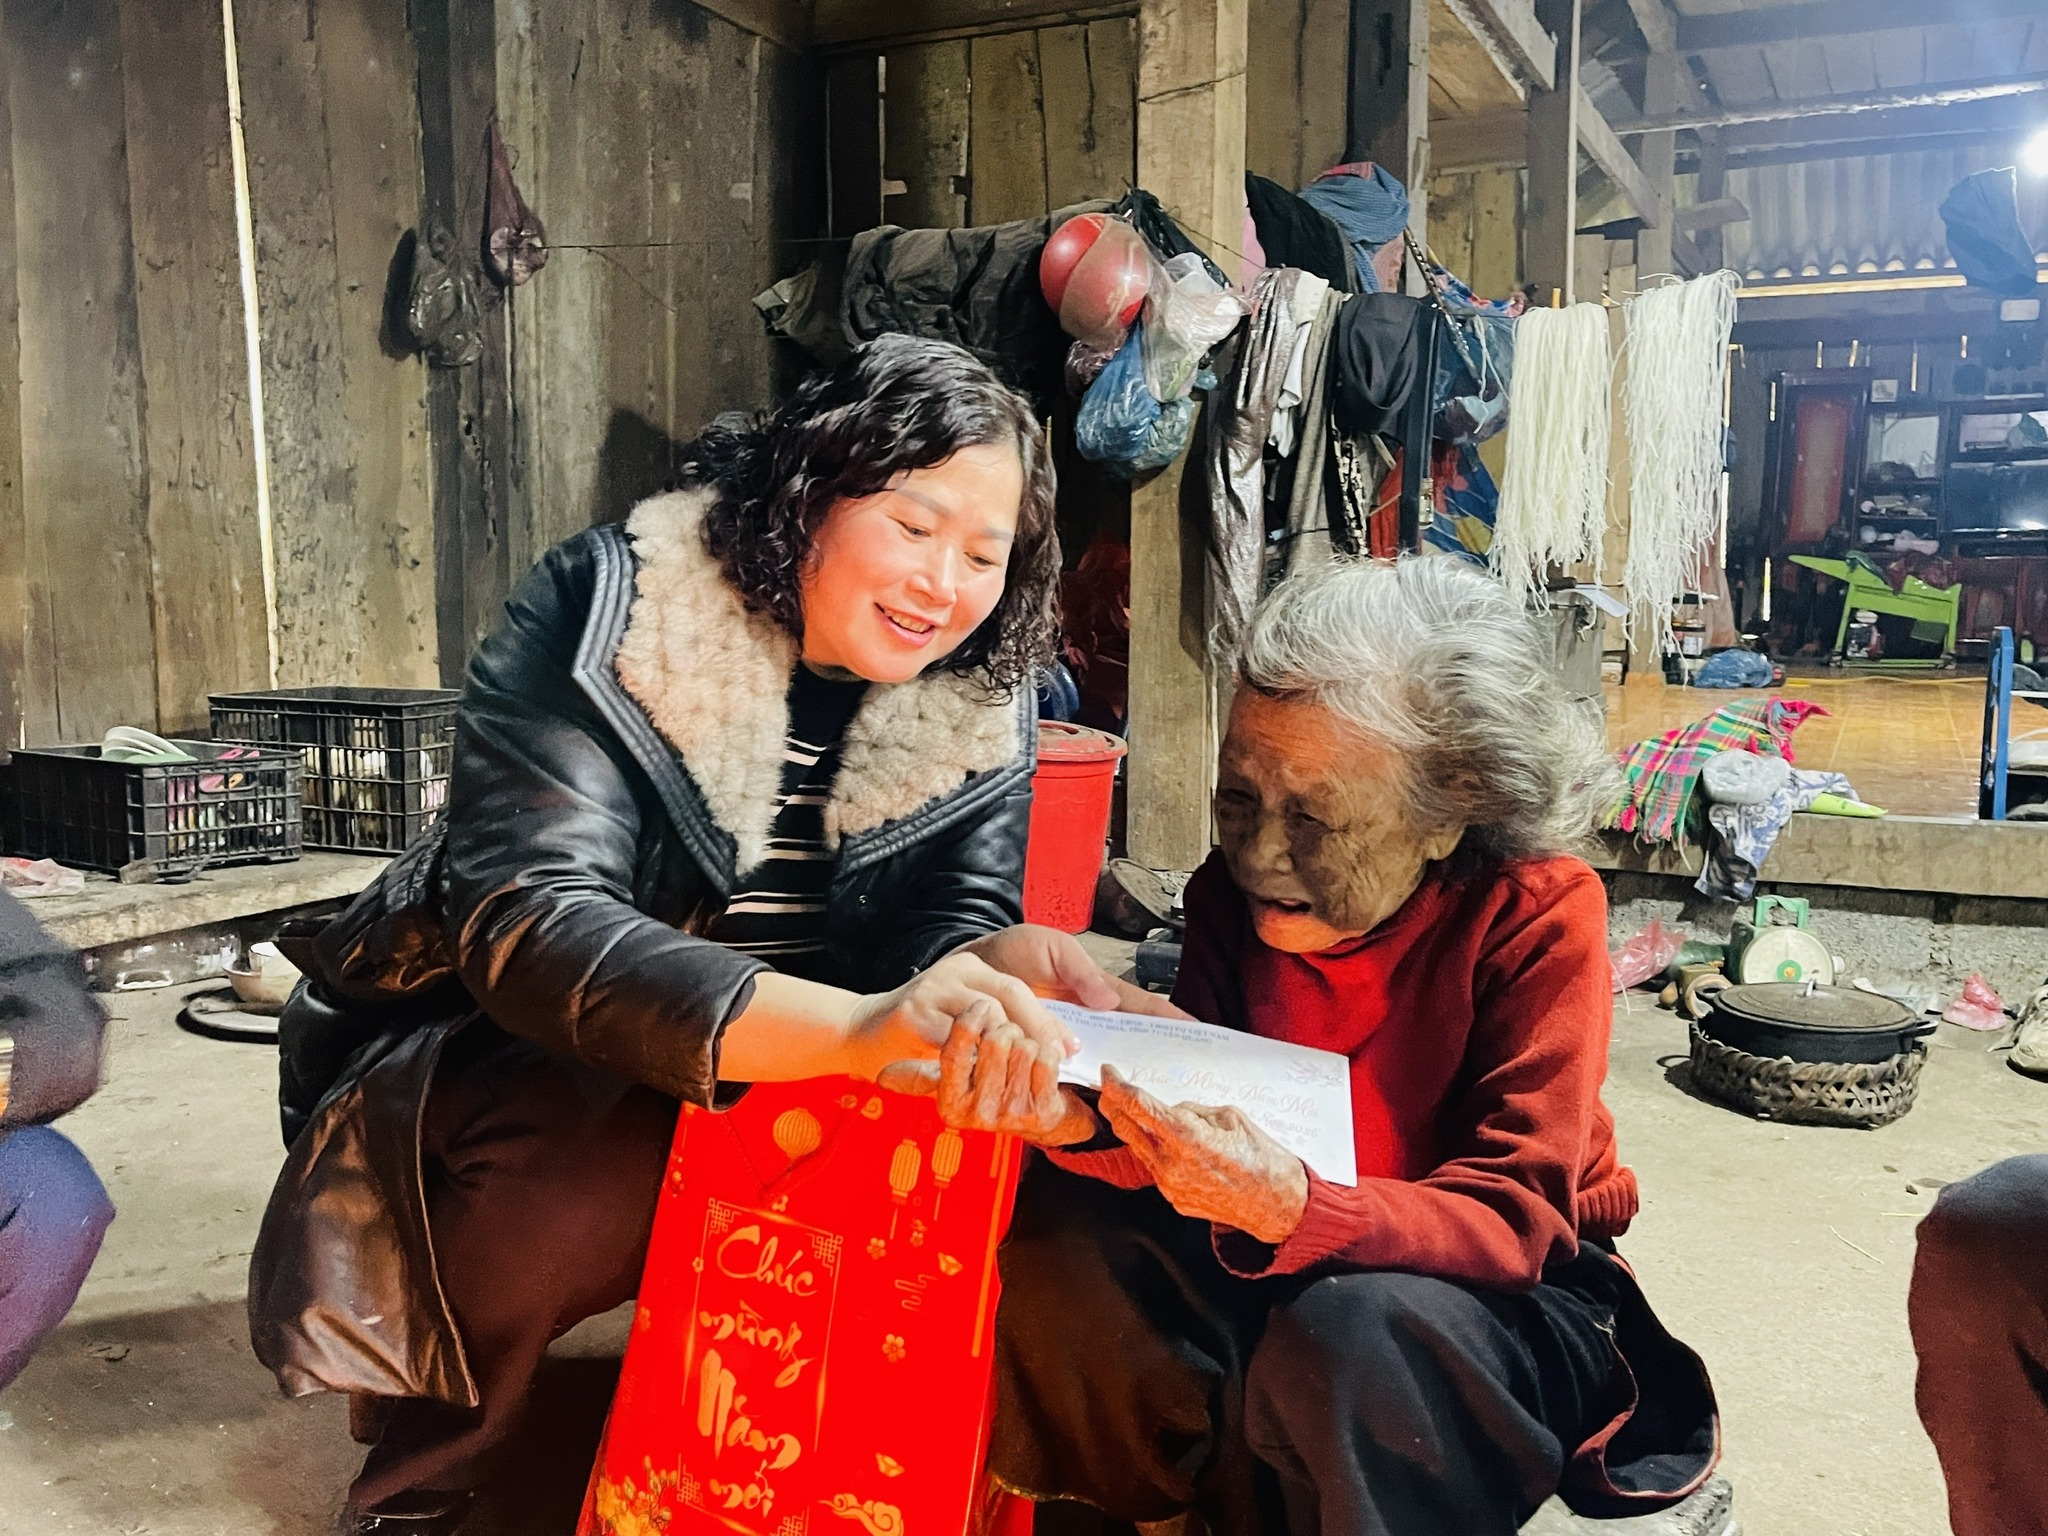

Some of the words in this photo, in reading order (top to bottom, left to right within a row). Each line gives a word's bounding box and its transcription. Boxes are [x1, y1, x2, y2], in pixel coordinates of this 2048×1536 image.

[716, 1225, 818, 1297] Chúc
[700, 1300, 818, 1388] mừng
[697, 1348, 802, 1471] Năm
[709, 1459, 776, 1519] mới
